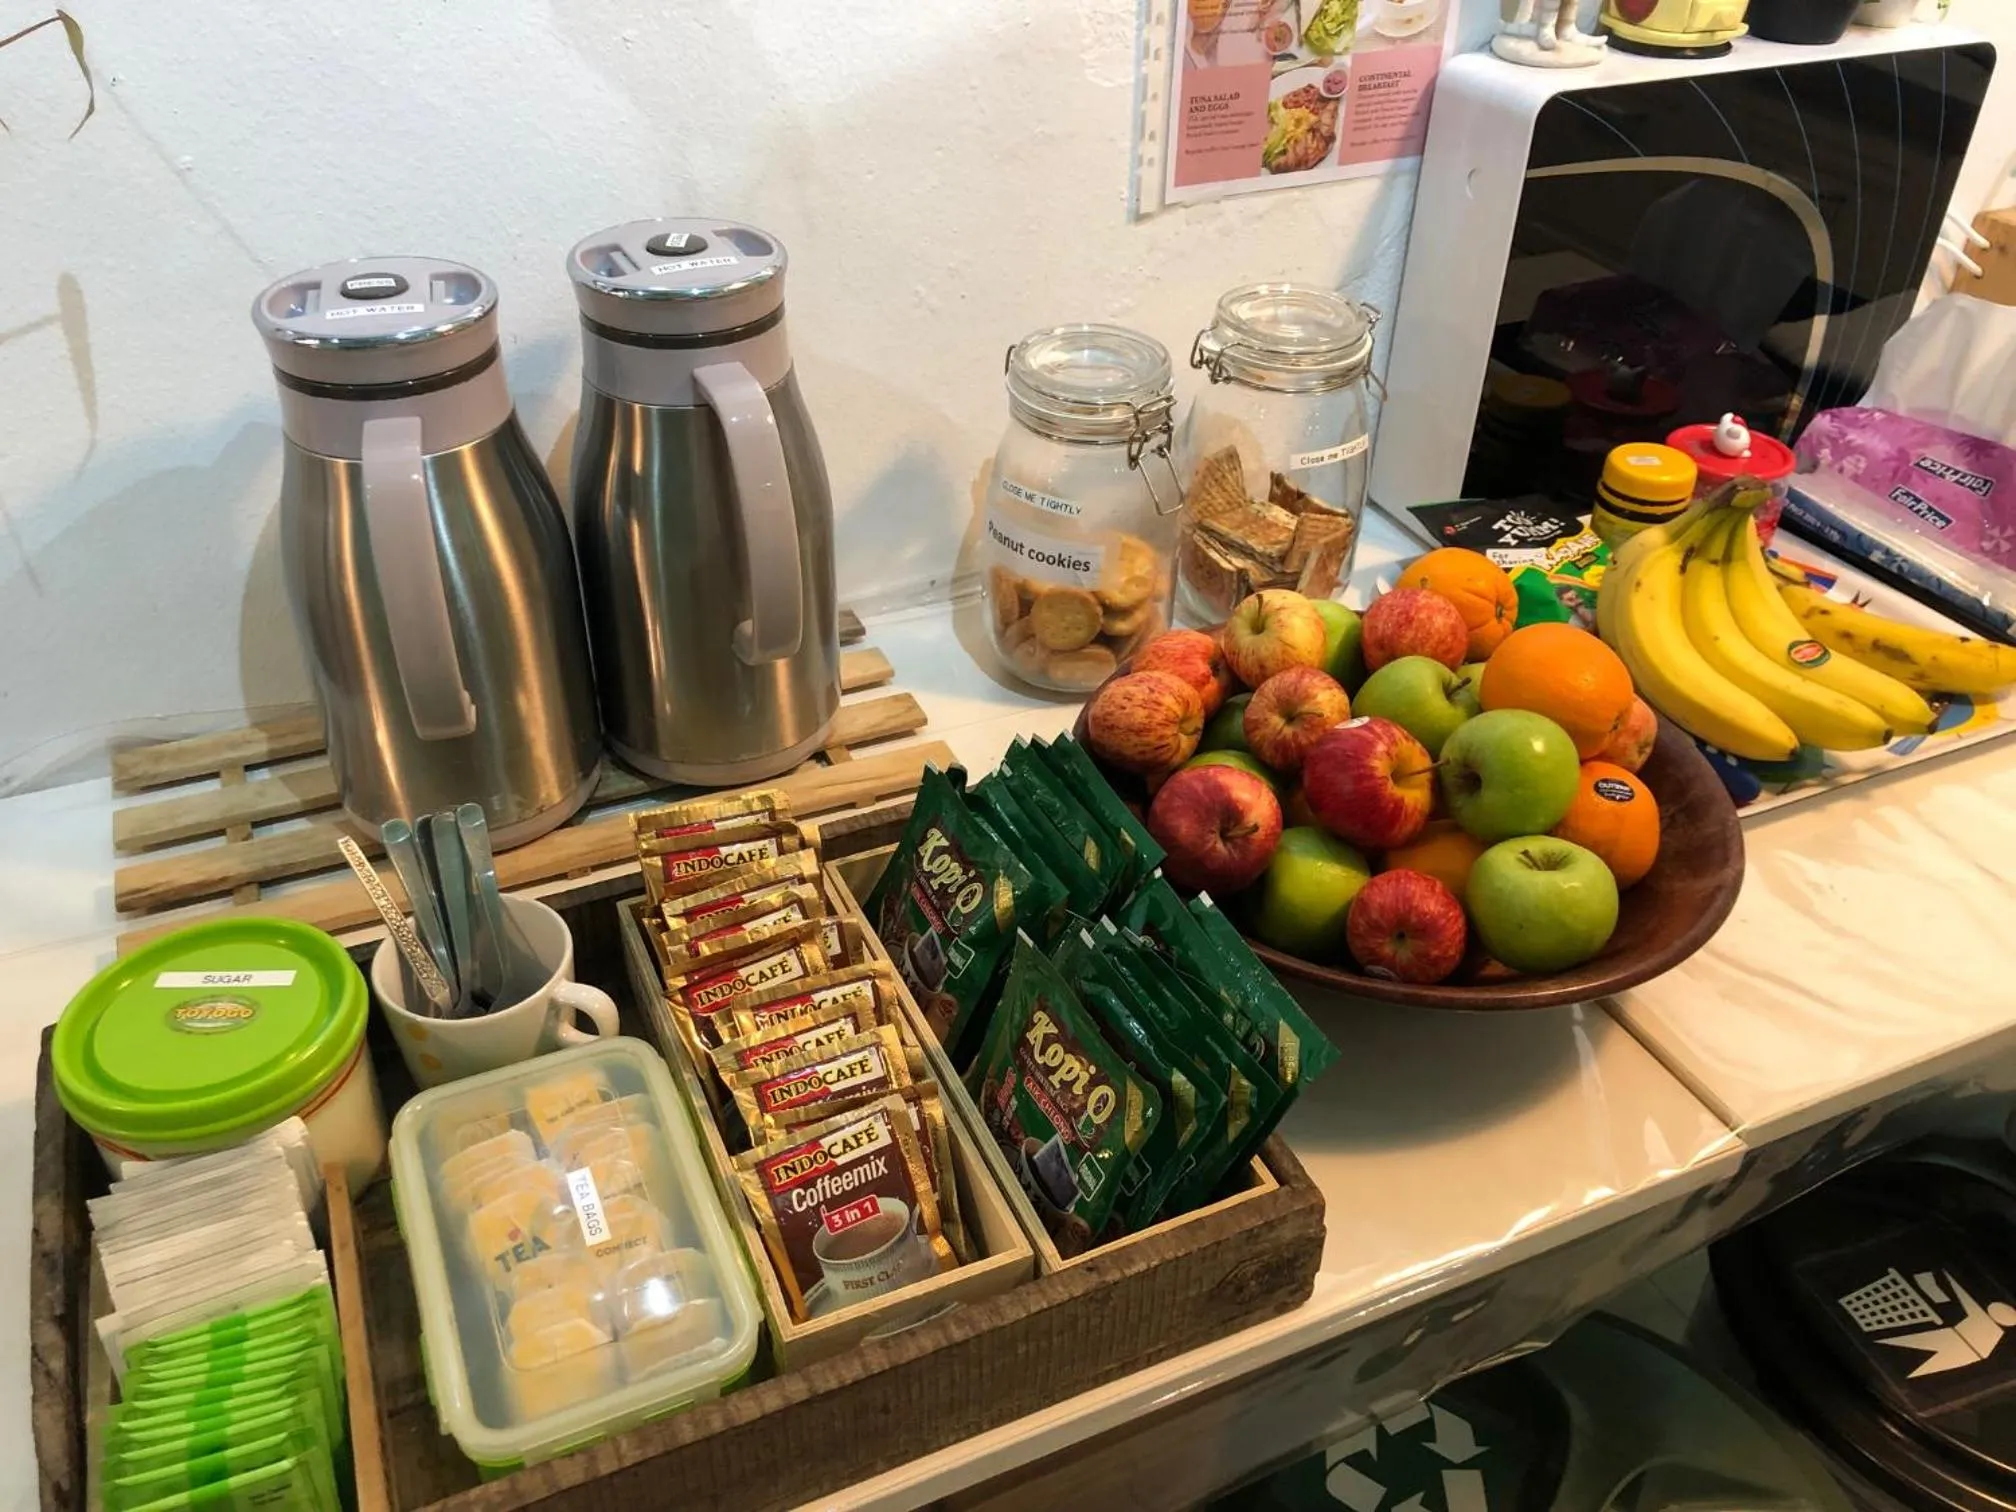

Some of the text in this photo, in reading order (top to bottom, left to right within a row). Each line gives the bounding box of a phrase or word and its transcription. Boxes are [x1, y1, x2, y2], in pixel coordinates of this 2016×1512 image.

[366, 304, 415, 314] WATER
[1002, 480, 1082, 515] CLOSE ME TIGHTLY
[1890, 488, 1947, 528] FairPrice
[988, 519, 1092, 573] Peanut cookies
[918, 827, 976, 894] Kopi
[955, 882, 984, 914] O
[202, 975, 253, 984] SUGAR
[696, 956, 793, 1006] INDOCAFÉ
[770, 1056, 873, 1104] INDOCAFÉ
[1026, 1010, 1097, 1095] Kopi
[1087, 1085, 1116, 1125] O
[773, 1123, 880, 1185] INDOCAFÉ
[574, 1174, 603, 1237] TEA BAGS
[792, 1154, 889, 1213] Coffeemix
[831, 1202, 874, 1228] 3 in 1
[494, 1234, 552, 1273] TEA
[843, 1275, 876, 1291] FIRST
